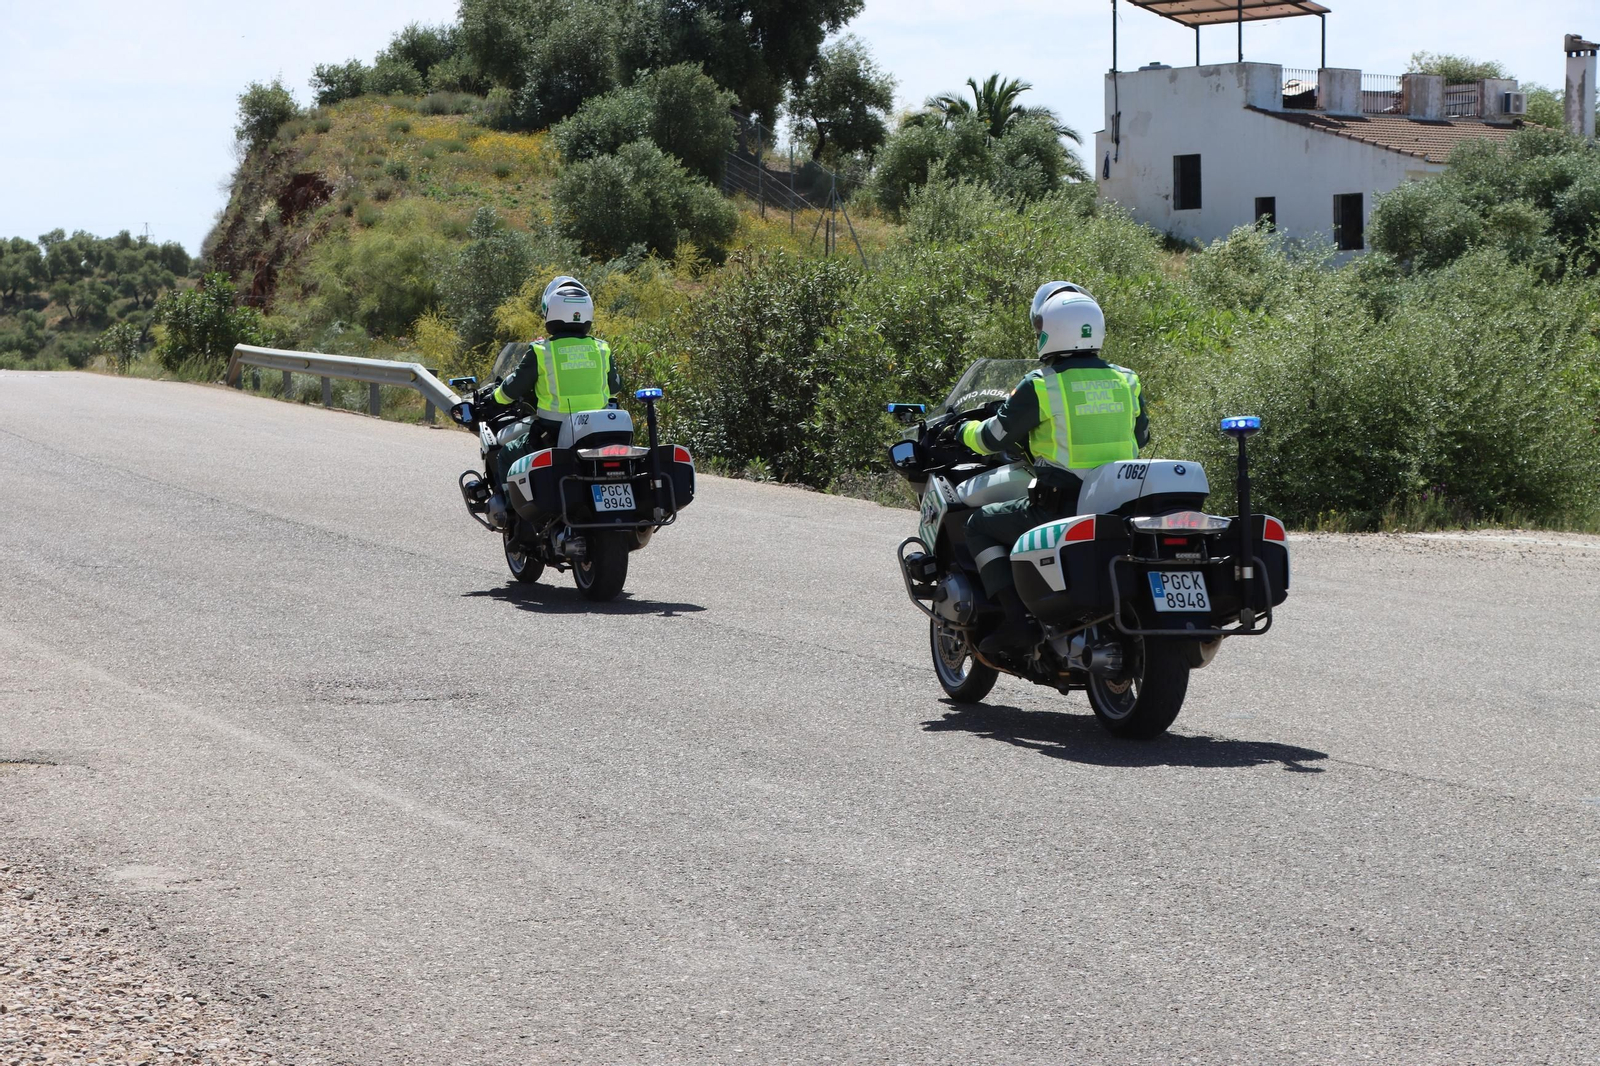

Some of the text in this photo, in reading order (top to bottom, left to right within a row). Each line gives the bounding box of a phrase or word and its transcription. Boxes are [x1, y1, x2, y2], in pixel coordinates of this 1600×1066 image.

[558, 345, 594, 354] GUARDIA
[568, 353, 588, 361] CIVIL
[1072, 380, 1121, 392] GUARDIA
[1086, 390, 1112, 401] CIVIL
[1124, 464, 1146, 480] 062
[600, 485, 630, 497] PGCK
[603, 497, 632, 509] 8949
[1160, 574, 1203, 590] PGCK
[1166, 592, 1206, 609] 8948
